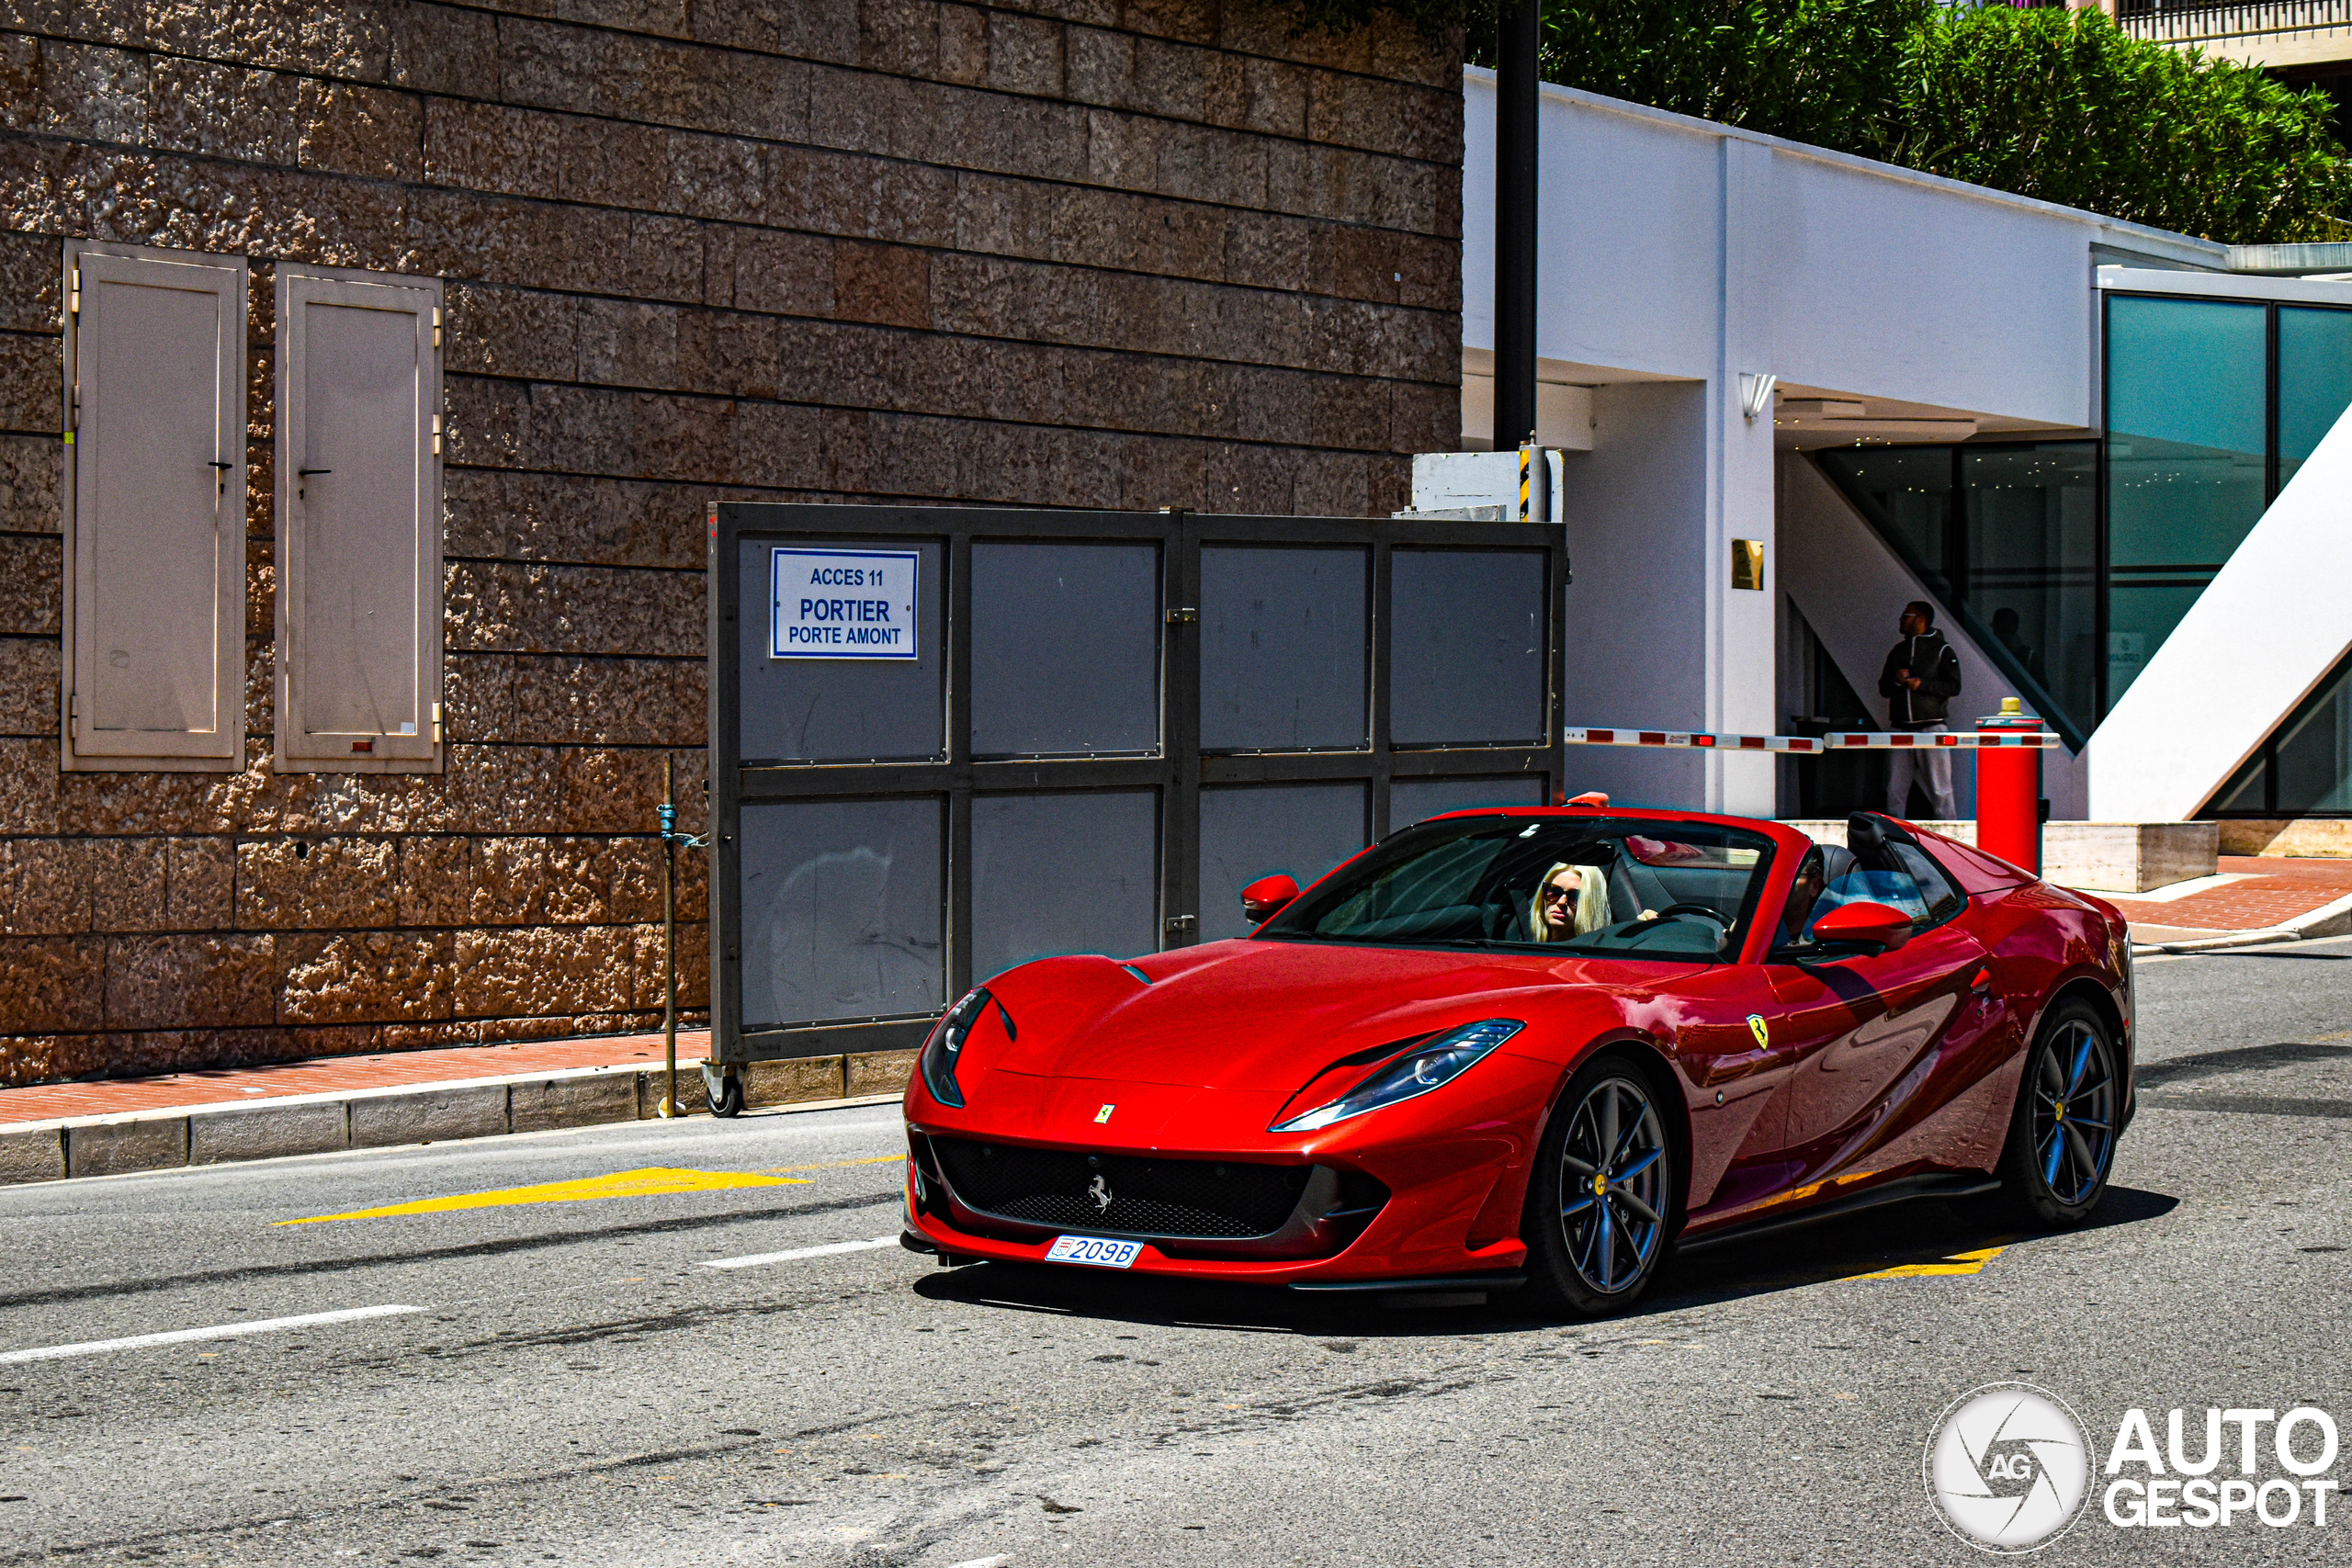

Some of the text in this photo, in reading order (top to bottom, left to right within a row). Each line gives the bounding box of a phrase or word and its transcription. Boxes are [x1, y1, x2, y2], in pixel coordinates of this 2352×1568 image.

[810, 568, 883, 586] ACCES 11
[800, 599, 889, 622] PORTIER
[789, 626, 901, 644] PORTE AMONT
[1069, 1240, 1134, 1262] 209B
